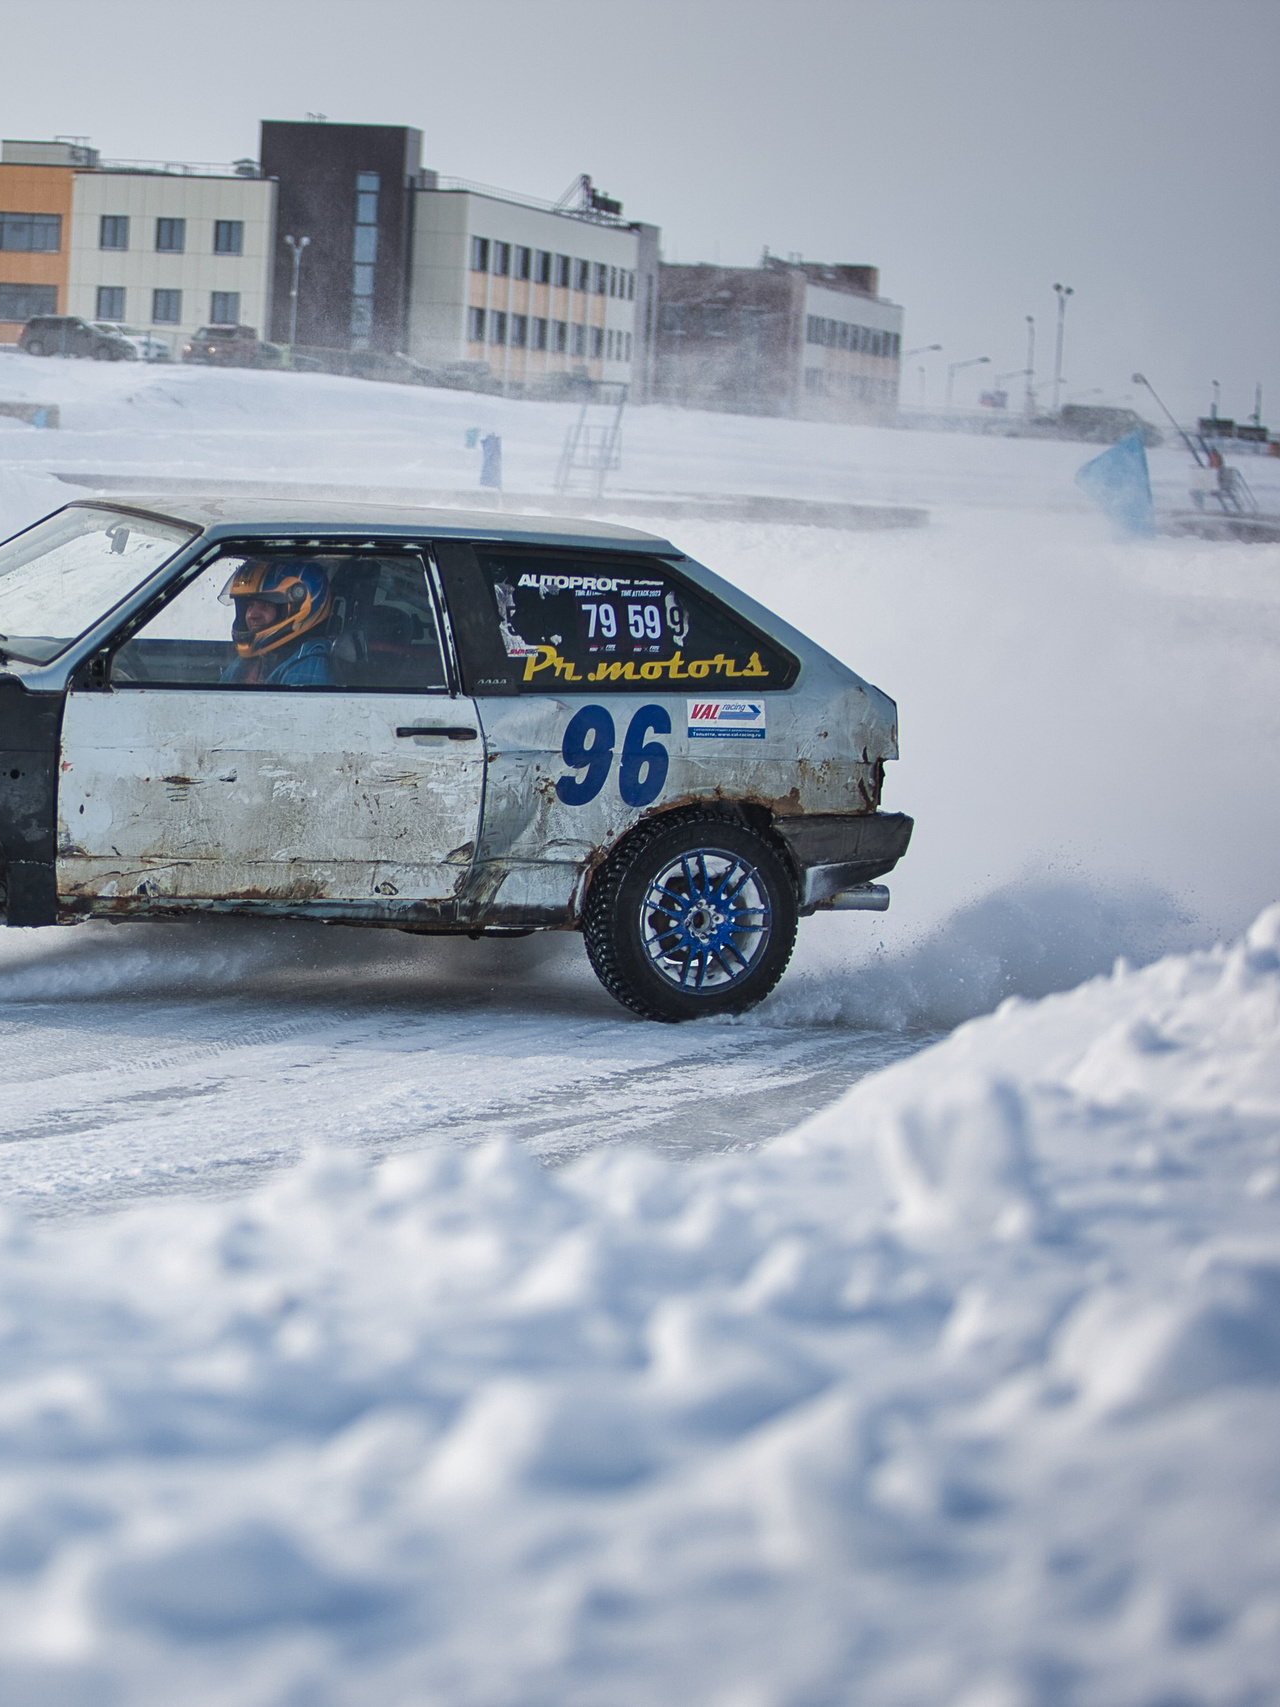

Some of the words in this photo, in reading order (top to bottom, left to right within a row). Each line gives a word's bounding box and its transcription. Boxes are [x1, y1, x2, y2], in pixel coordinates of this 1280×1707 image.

[581, 603, 617, 638] 79
[627, 604, 661, 639] 59
[690, 704, 721, 720] VAL
[722, 702, 746, 712] racing
[556, 704, 672, 808] 96
